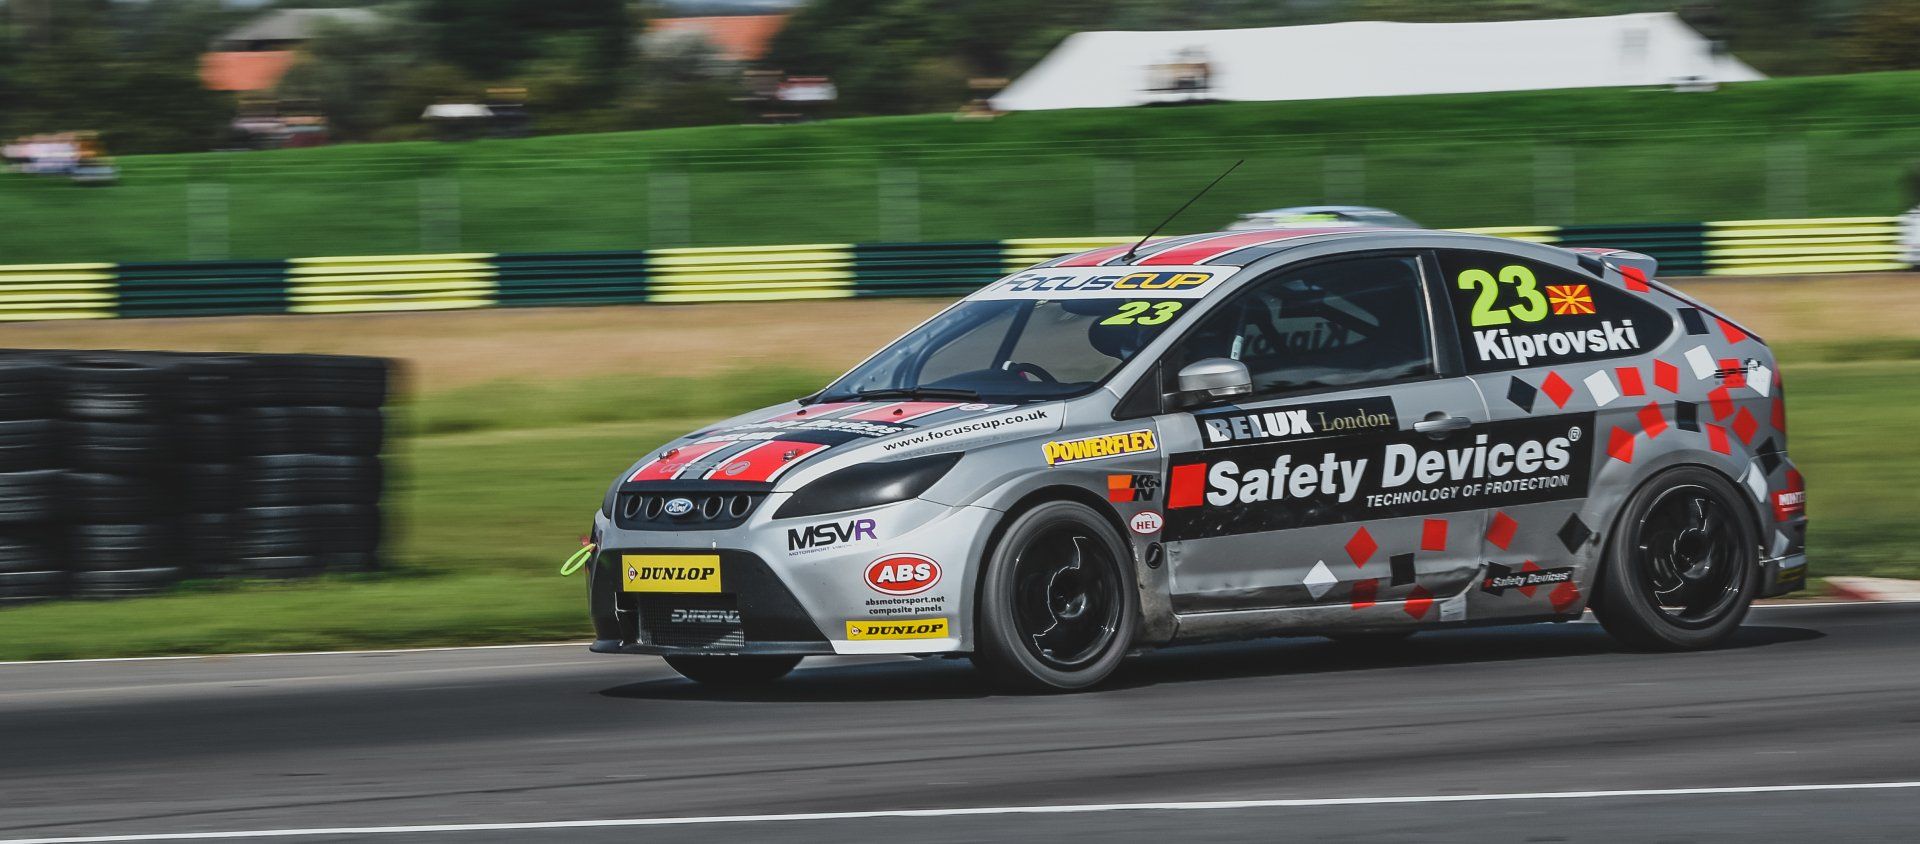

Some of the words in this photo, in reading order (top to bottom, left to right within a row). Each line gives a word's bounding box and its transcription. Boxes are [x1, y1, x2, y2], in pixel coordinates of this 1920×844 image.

[1457, 264, 1548, 327] 23
[1099, 301, 1183, 326] 23
[1472, 319, 1640, 366] Kiprovski
[883, 409, 1047, 451] www.focuscup.co.uk
[1204, 409, 1314, 443] BELUX
[1317, 408, 1391, 432] London
[1045, 429, 1157, 465] POWERFLEX
[1206, 452, 1368, 507] Safety
[1366, 486, 1459, 508] TECHNOLOGY
[1462, 484, 1482, 498] OF
[1484, 474, 1571, 495] PROTECTION
[787, 518, 878, 551] MSVR
[1136, 520, 1158, 530] HEL
[788, 546, 830, 557] MOTORSPORT
[640, 567, 715, 581] DUNLOP
[876, 563, 931, 583] ABS
[1492, 575, 1527, 587] Safety
[865, 595, 945, 606] absmotorsport.net
[869, 606, 912, 616] composite
[915, 604, 942, 615] panels
[866, 623, 943, 636] DUNLOP
